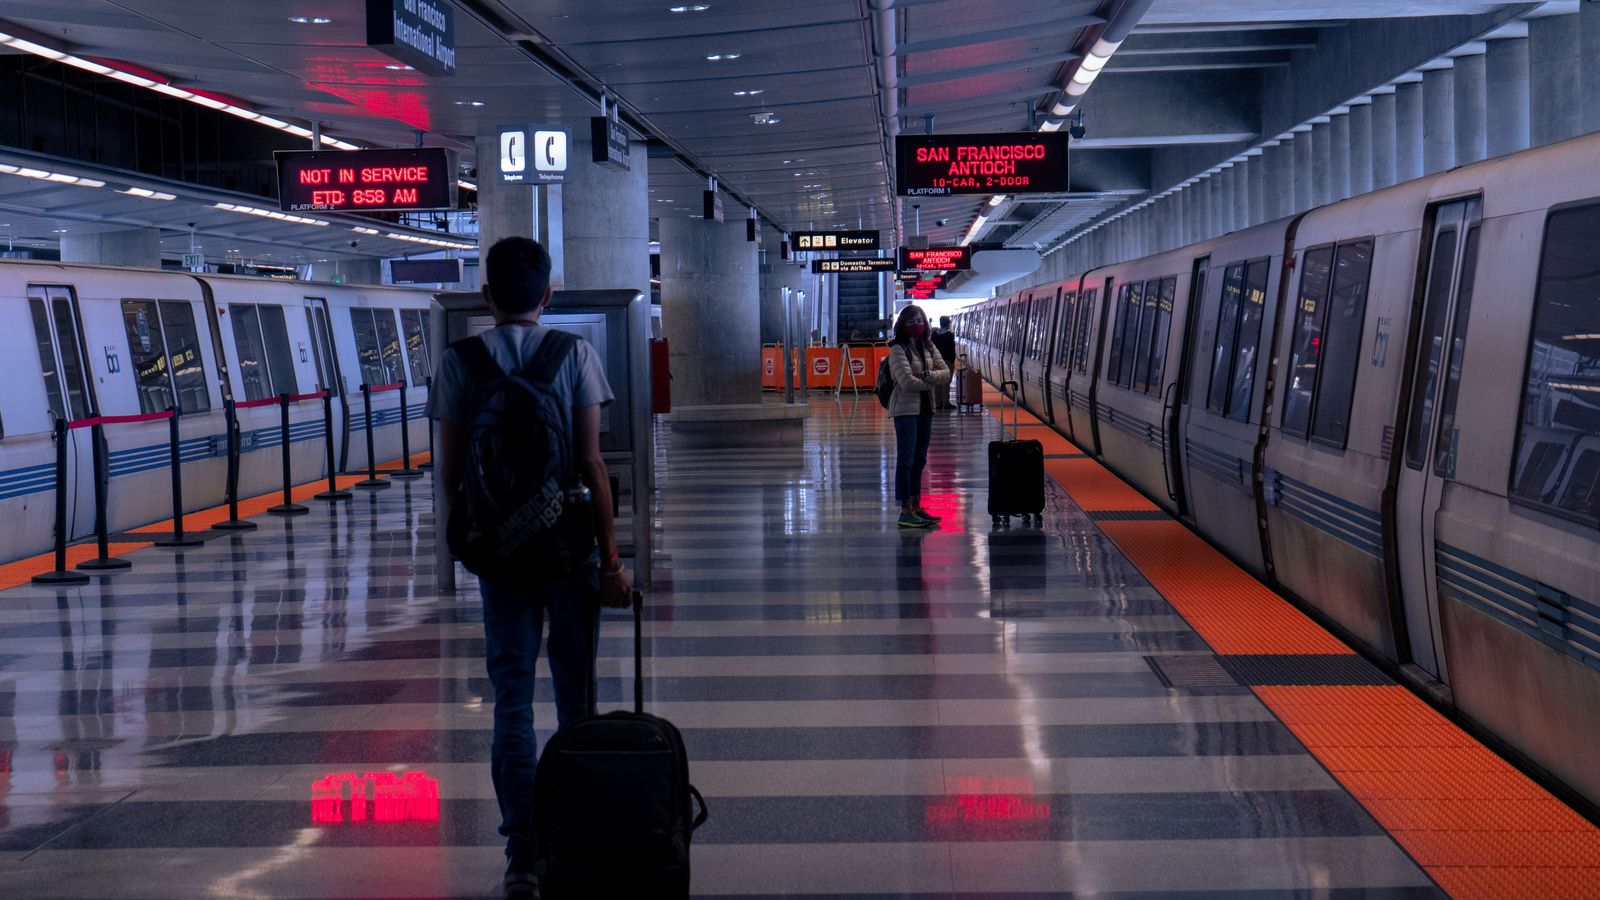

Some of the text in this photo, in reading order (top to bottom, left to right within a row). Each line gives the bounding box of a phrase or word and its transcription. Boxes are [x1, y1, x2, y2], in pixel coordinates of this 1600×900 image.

[394, 9, 456, 70] International Airport
[916, 144, 1046, 162] SAN FRANCISCO
[299, 166, 428, 184] NOT IN SERVICE
[948, 160, 1015, 176] ANTIOCH
[538, 173, 564, 181] Telephone
[933, 176, 1030, 188] 10-CAR, 2-DOOR
[312, 188, 417, 205] ETD: 8:58 AM
[840, 236, 874, 245] Elevator
[185, 255, 199, 265] EXIT
[910, 251, 924, 259] SAN
[496, 476, 561, 543] AMERICAN
